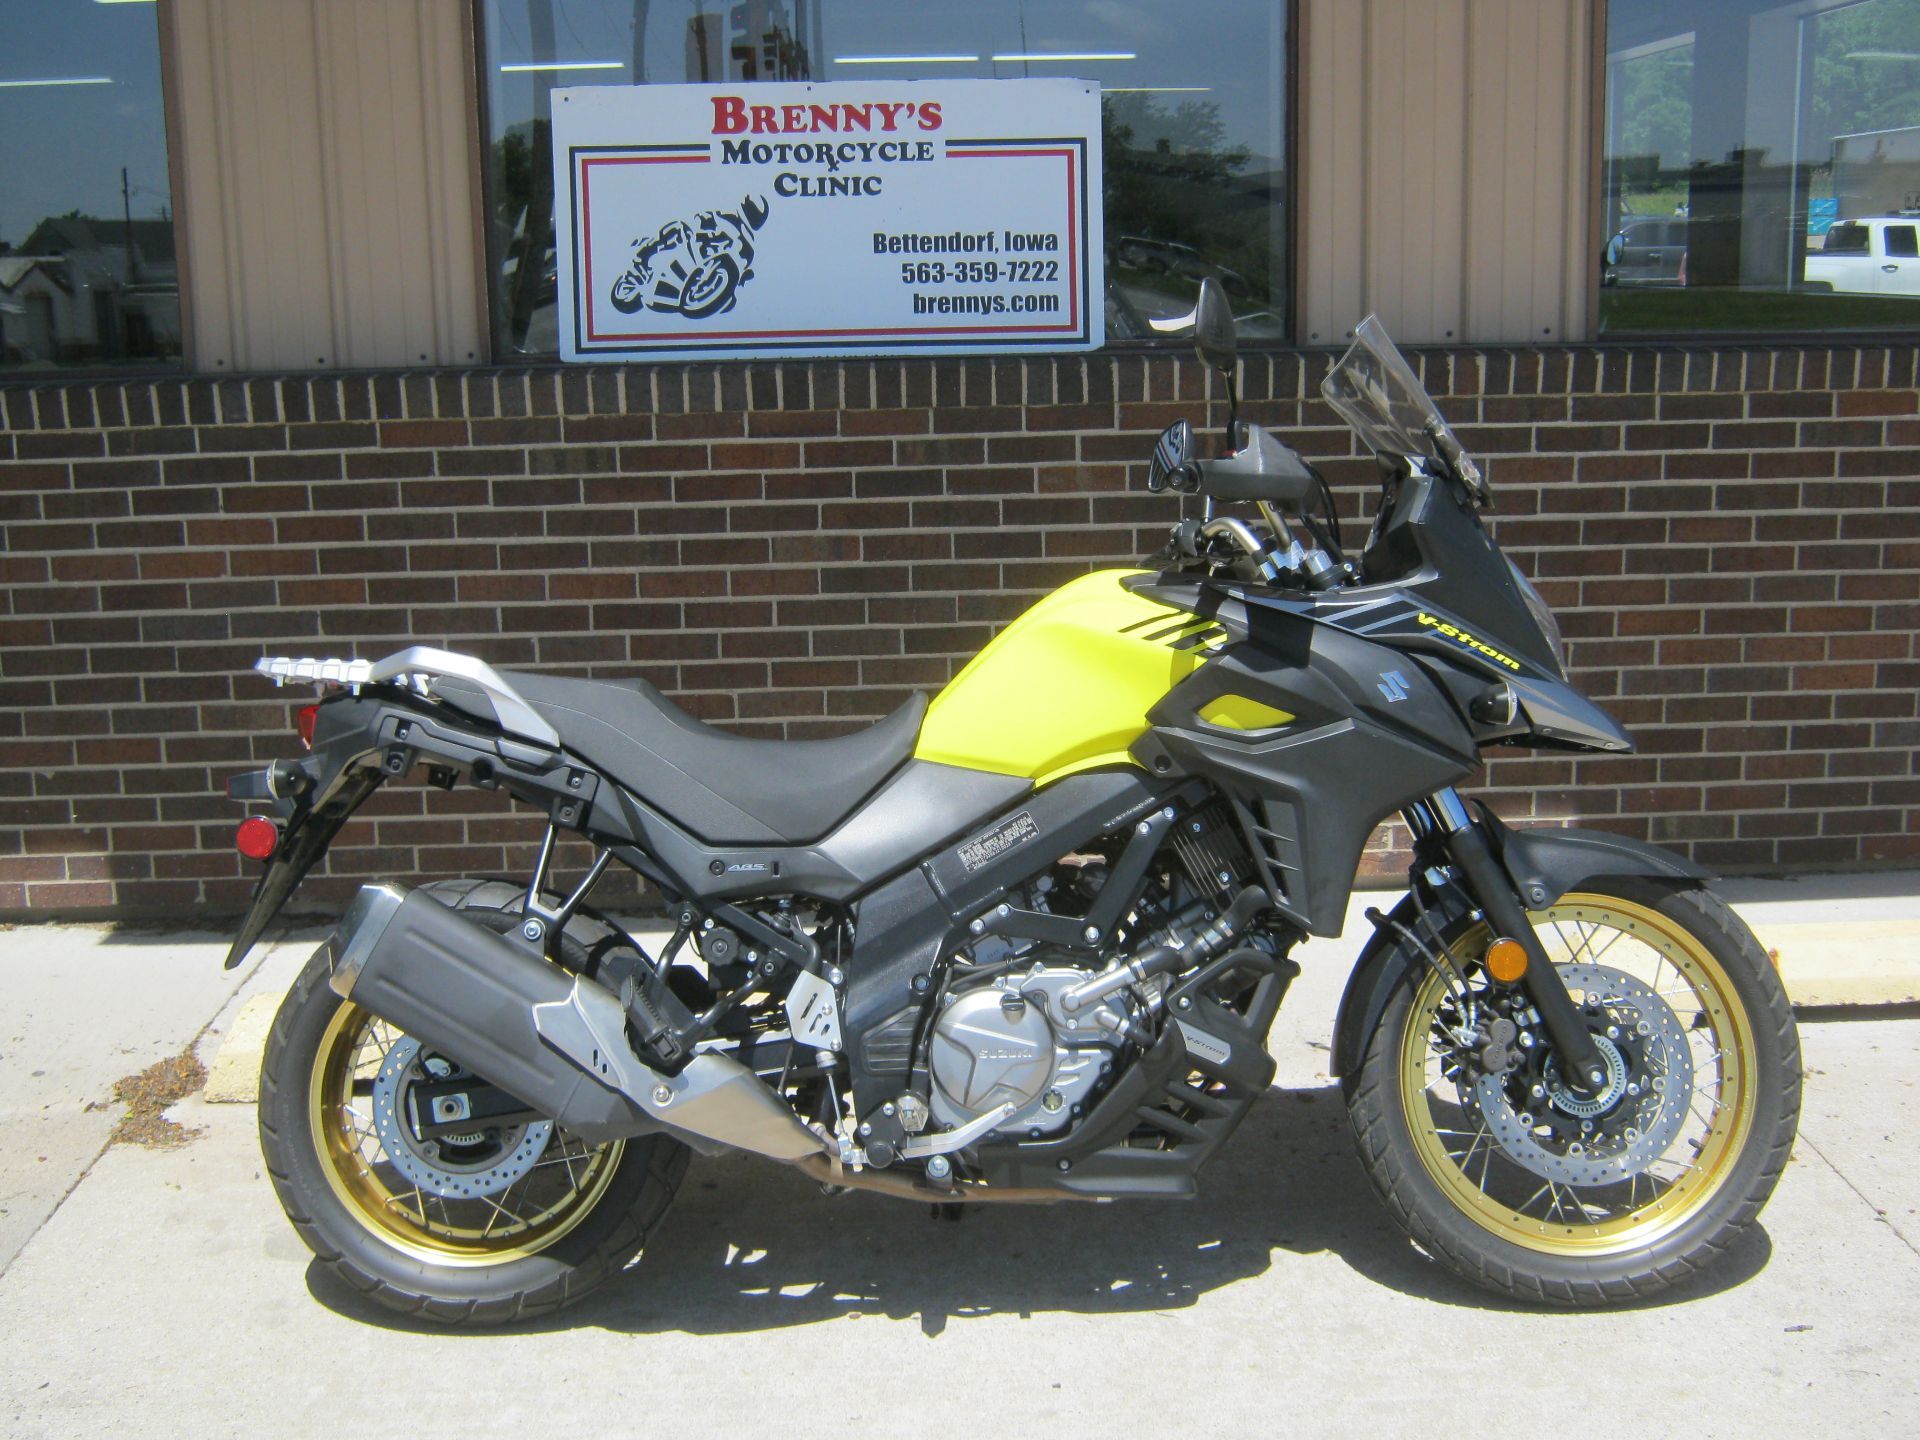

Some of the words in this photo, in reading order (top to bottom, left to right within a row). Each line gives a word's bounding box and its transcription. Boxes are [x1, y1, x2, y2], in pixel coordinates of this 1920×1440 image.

[711, 97, 943, 134] BRENNY'S
[721, 139, 935, 172] MOTORCYCLE
[774, 172, 882, 197] CLINIC
[873, 231, 999, 254] Bettendorf,
[1004, 231, 1058, 252] Iowa
[901, 260, 1059, 284] 563-359-7222
[913, 293, 1059, 315] brennys.com
[1418, 612, 1520, 670] V-Strom
[979, 1047, 1032, 1059] SUZUKI
